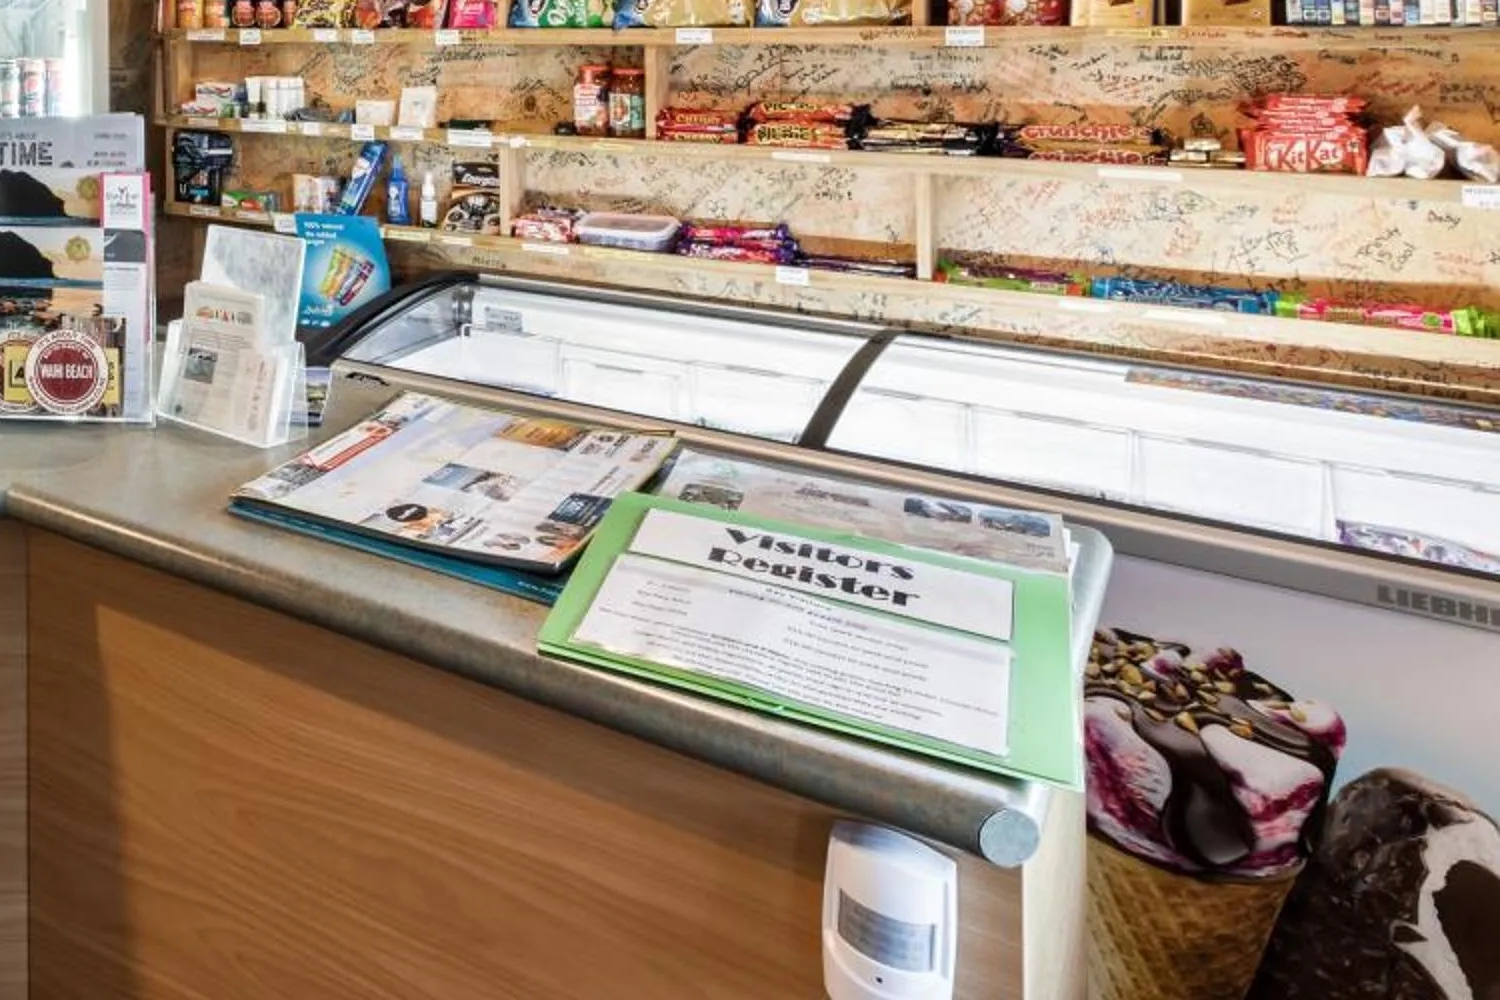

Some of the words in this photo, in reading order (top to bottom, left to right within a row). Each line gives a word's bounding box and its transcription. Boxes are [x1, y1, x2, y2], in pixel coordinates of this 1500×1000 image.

[65, 363, 94, 379] BEACH
[708, 546, 921, 607] Register
[725, 527, 915, 580] Visitors
